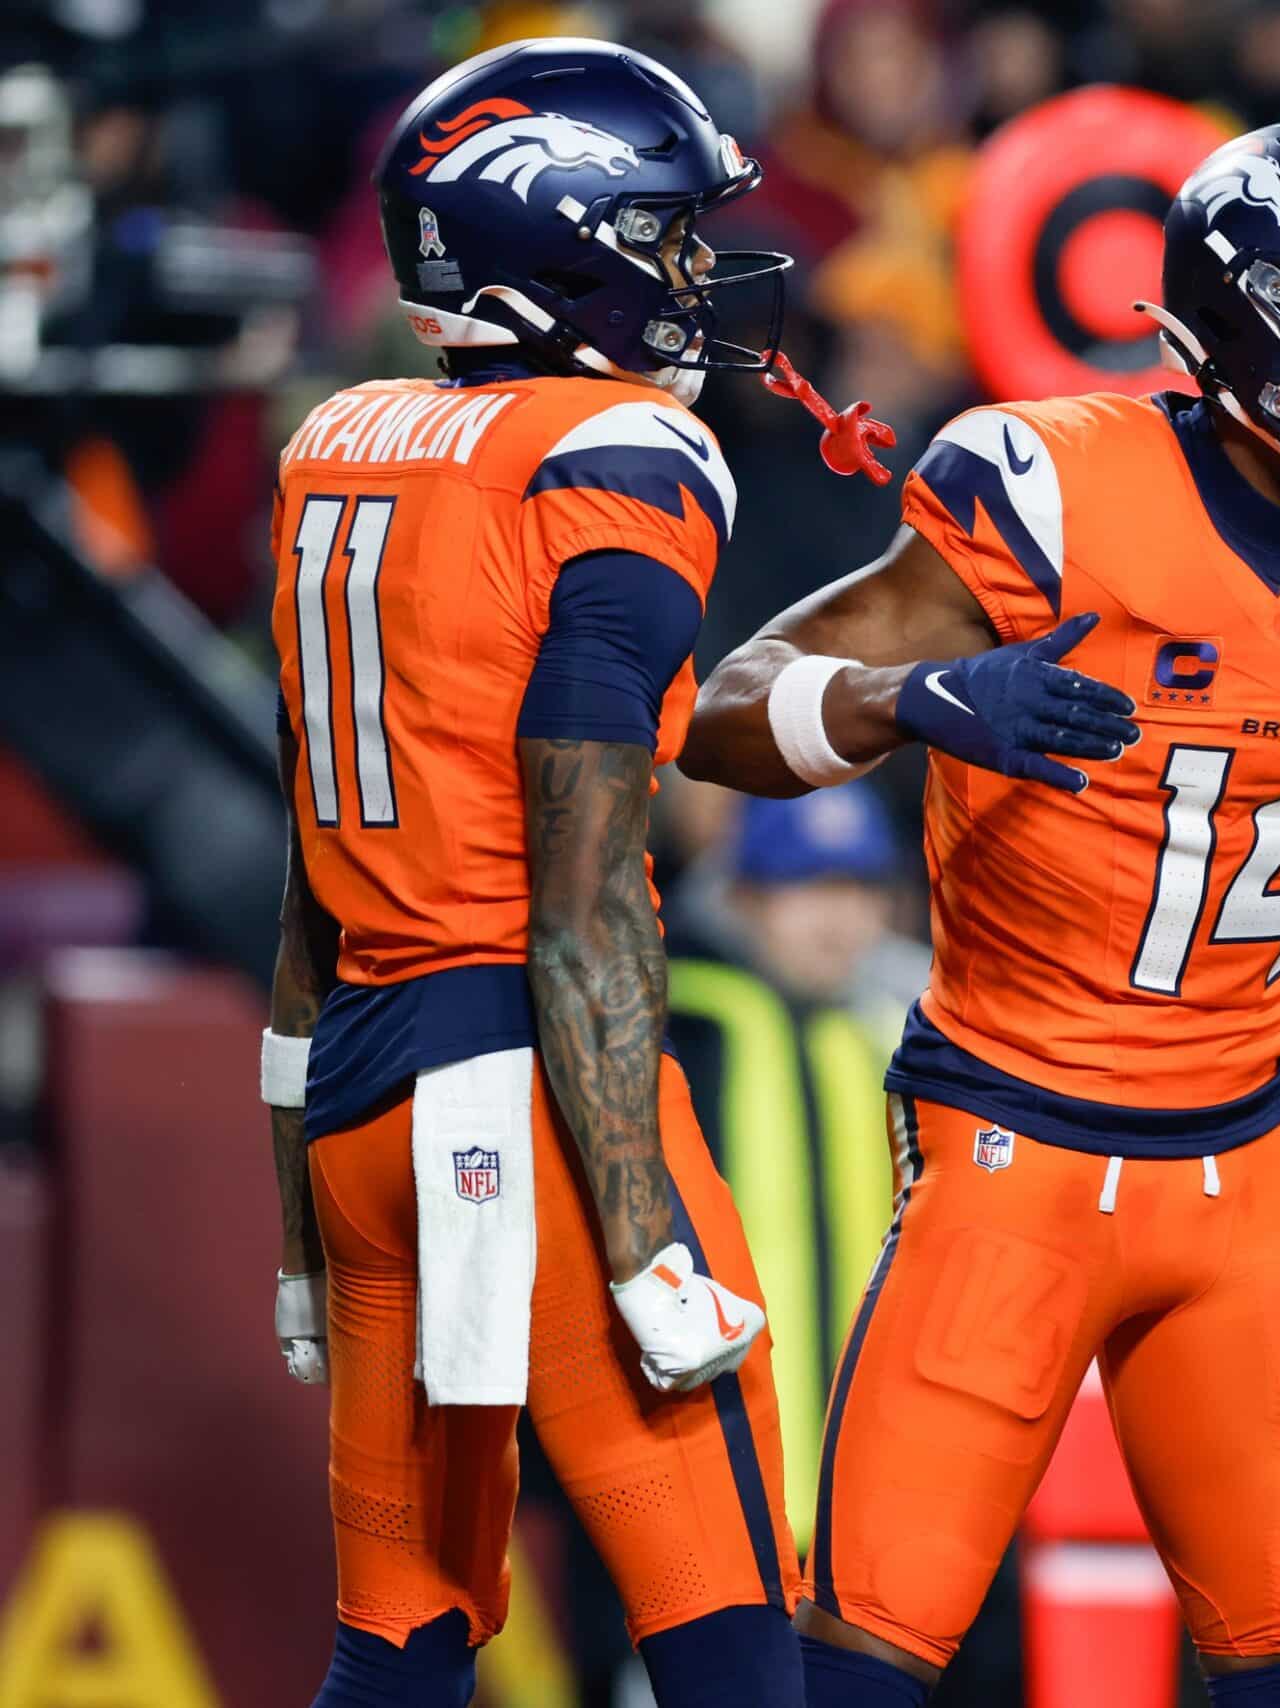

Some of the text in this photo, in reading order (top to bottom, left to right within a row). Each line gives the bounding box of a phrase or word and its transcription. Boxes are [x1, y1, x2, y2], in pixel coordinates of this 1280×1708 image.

[292, 493, 398, 828] 11
[1154, 641, 1219, 690] C
[980, 1144, 1005, 1163] NFL
[459, 1171, 496, 1198] NFL
